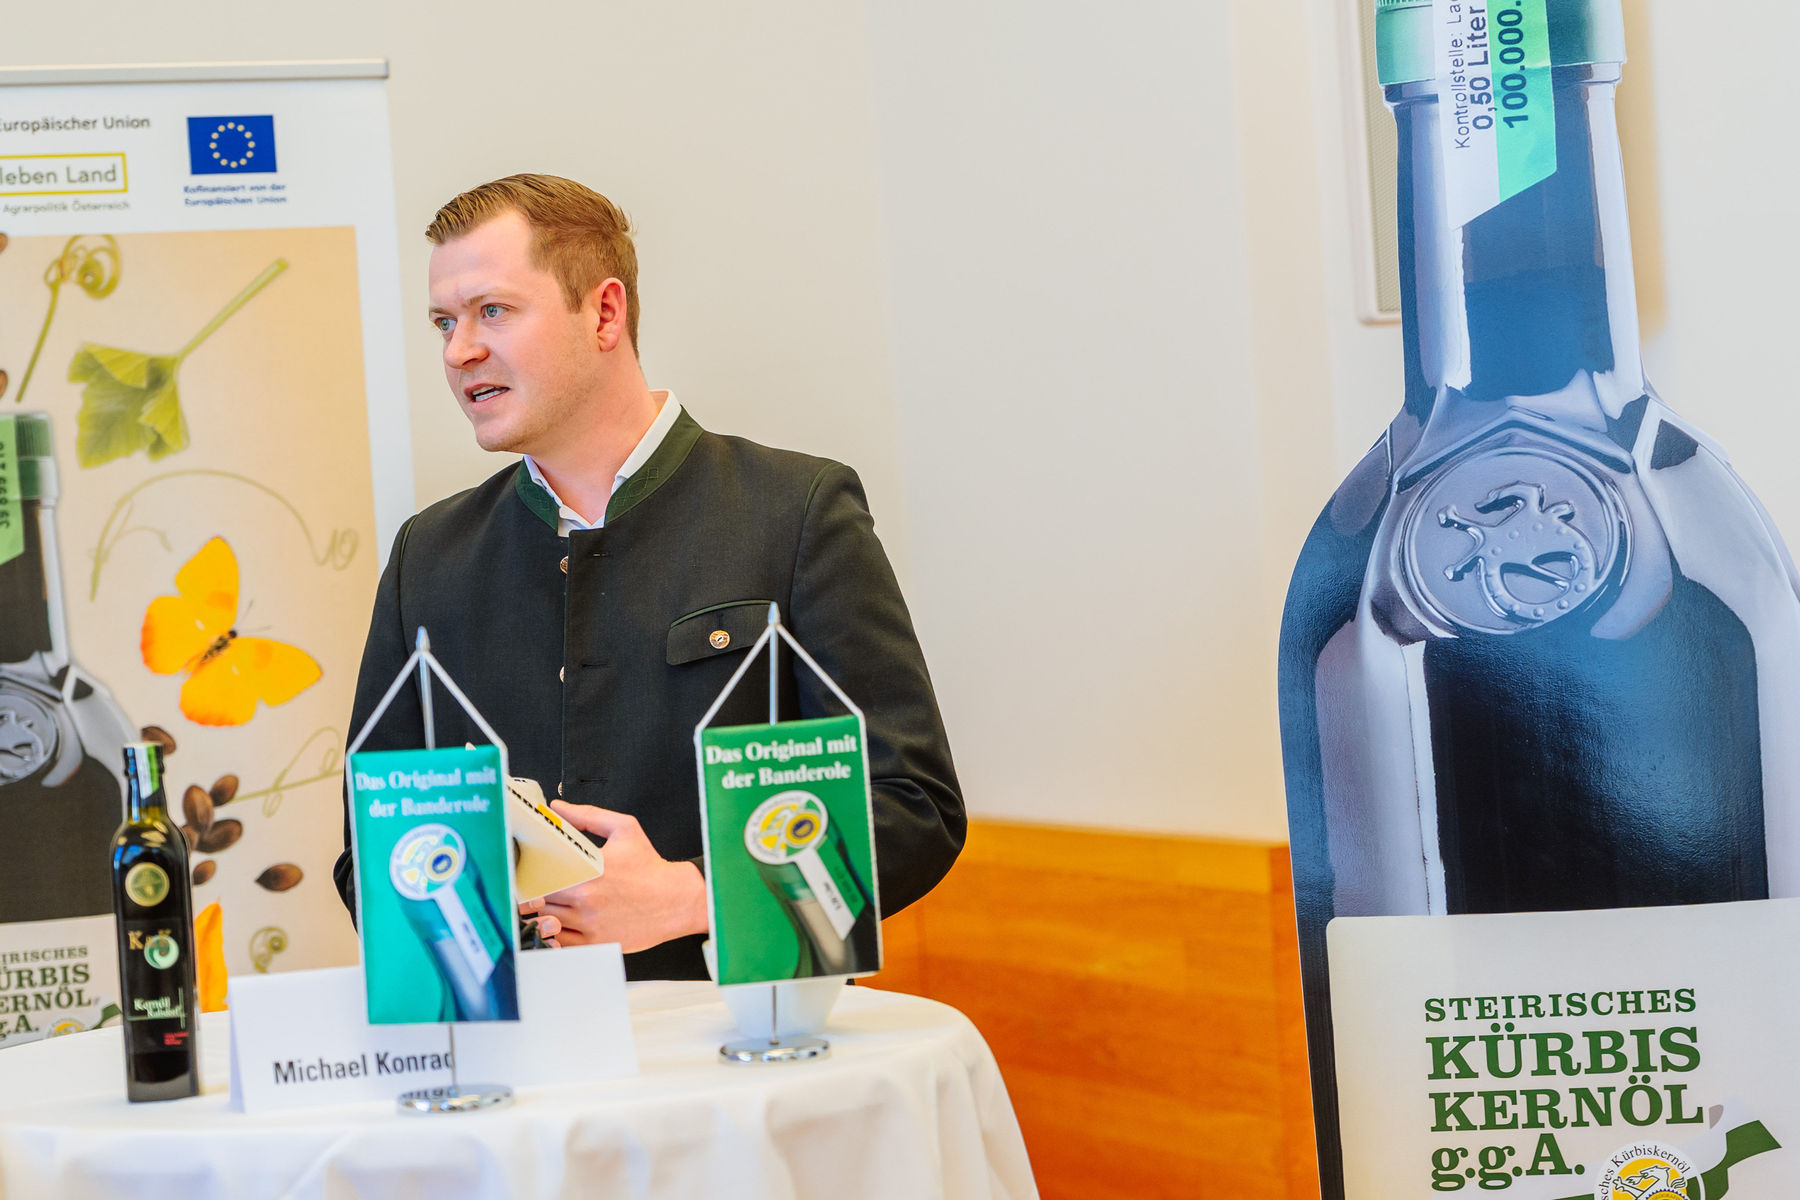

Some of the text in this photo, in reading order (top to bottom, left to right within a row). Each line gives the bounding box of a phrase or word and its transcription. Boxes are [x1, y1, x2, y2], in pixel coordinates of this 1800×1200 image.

[1466, 6, 1498, 130] 0,50 Liter
[1448, 32, 1470, 149] Kontrollstelle:
[0, 115, 150, 135] uropäischer Union
[0, 161, 117, 185] leben Land
[705, 733, 858, 765] Das Original mit
[355, 765, 498, 791] Das Original mit
[721, 761, 852, 789] der Banderole
[368, 794, 490, 818] der Banderole
[1424, 988, 1697, 1022] STEIRISCHES
[1425, 1022, 1701, 1080] KÜRBIS
[273, 1054, 368, 1084] Michael
[1428, 1075, 1704, 1132] KERNÖL
[1431, 1133, 1586, 1192] g.g.A.
[1611, 1144, 1691, 1174] Kürbiskernöl
